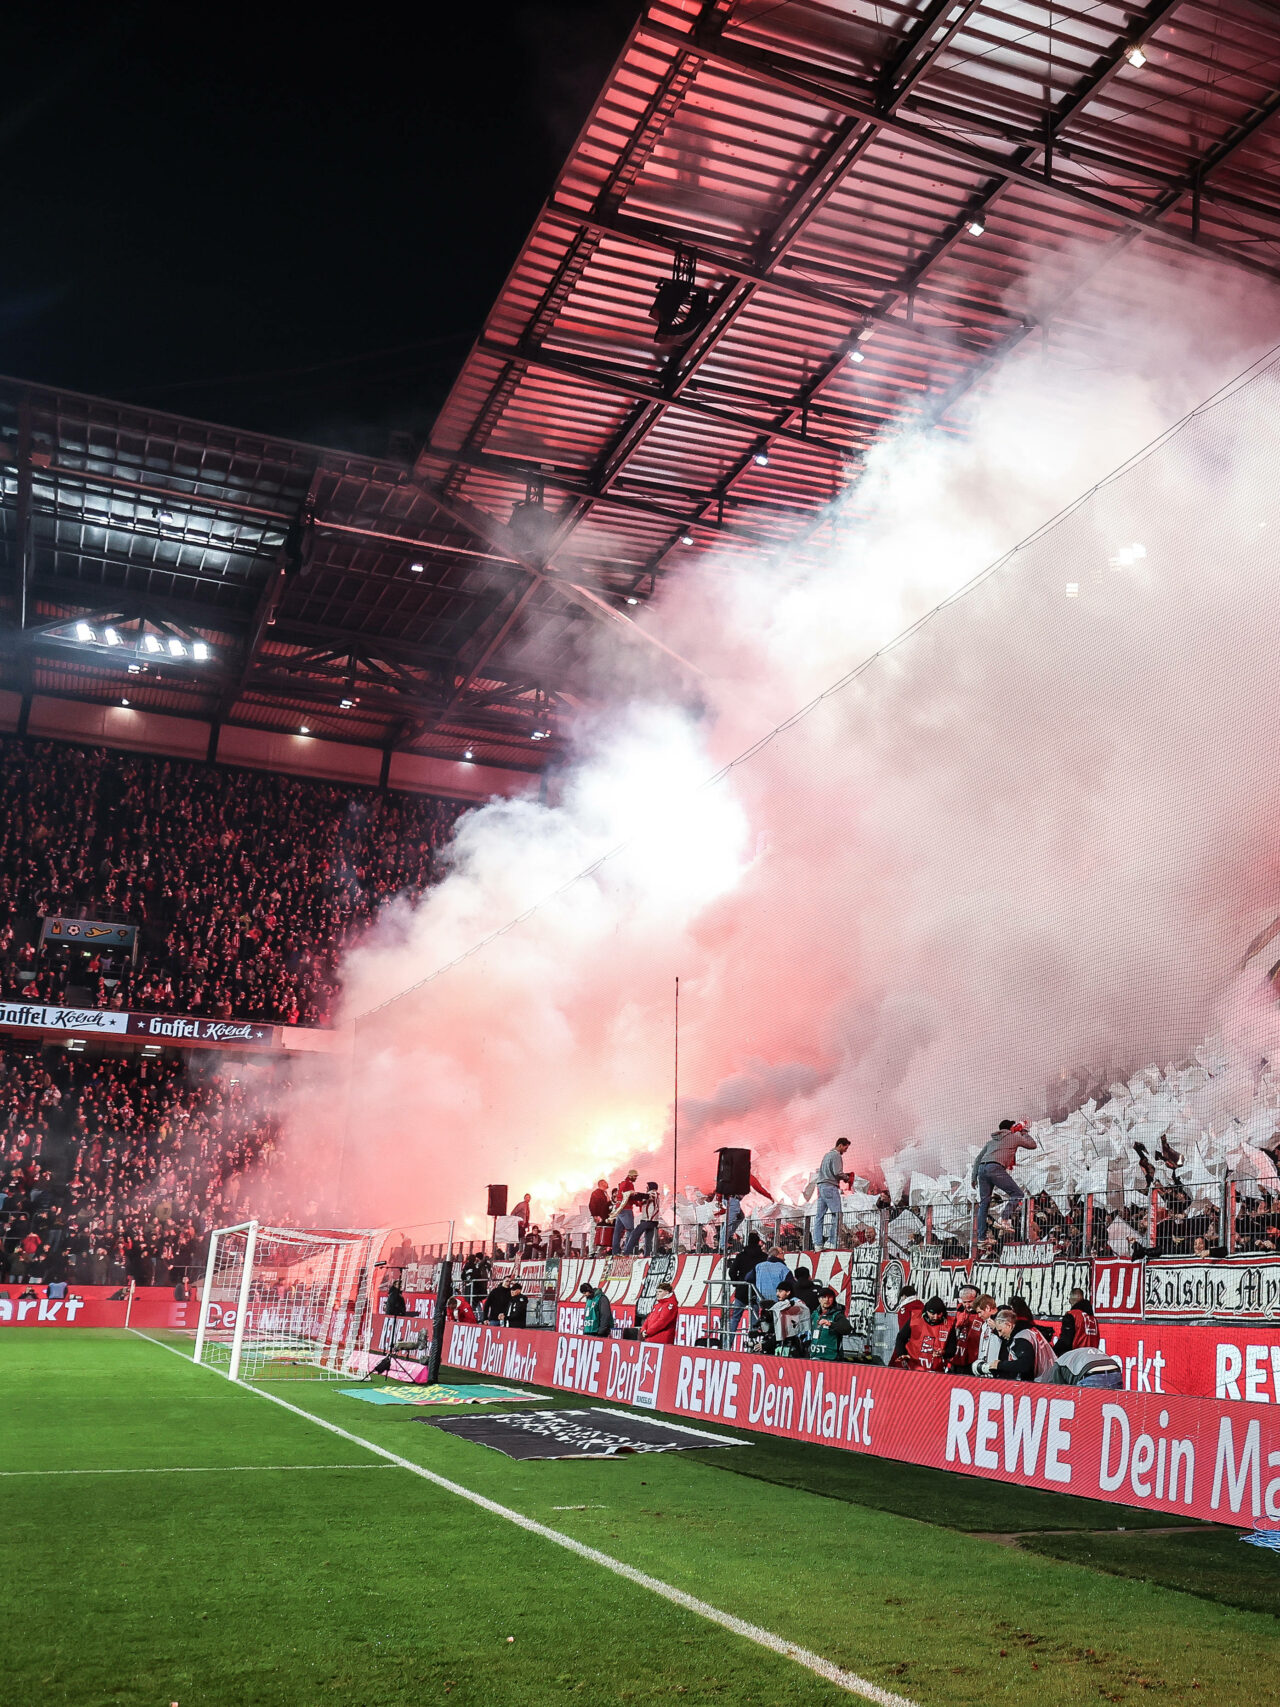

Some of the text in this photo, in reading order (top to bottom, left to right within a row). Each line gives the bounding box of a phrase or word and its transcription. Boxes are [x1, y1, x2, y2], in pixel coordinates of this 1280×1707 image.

[51, 1010, 105, 1028] Kölsch
[149, 1017, 253, 1040] Gaffel Kölsch
[0, 1299, 84, 1321] arkt
[559, 1307, 584, 1335] REW
[448, 1325, 538, 1382] REWE Dein Markt
[811, 1344, 826, 1353] OST
[552, 1336, 603, 1394] REWE
[675, 1355, 741, 1419] REWE
[748, 1363, 794, 1430] Dein
[798, 1370, 875, 1446] Markt
[945, 1387, 1075, 1484] REWE
[1100, 1403, 1195, 1505] Dein
